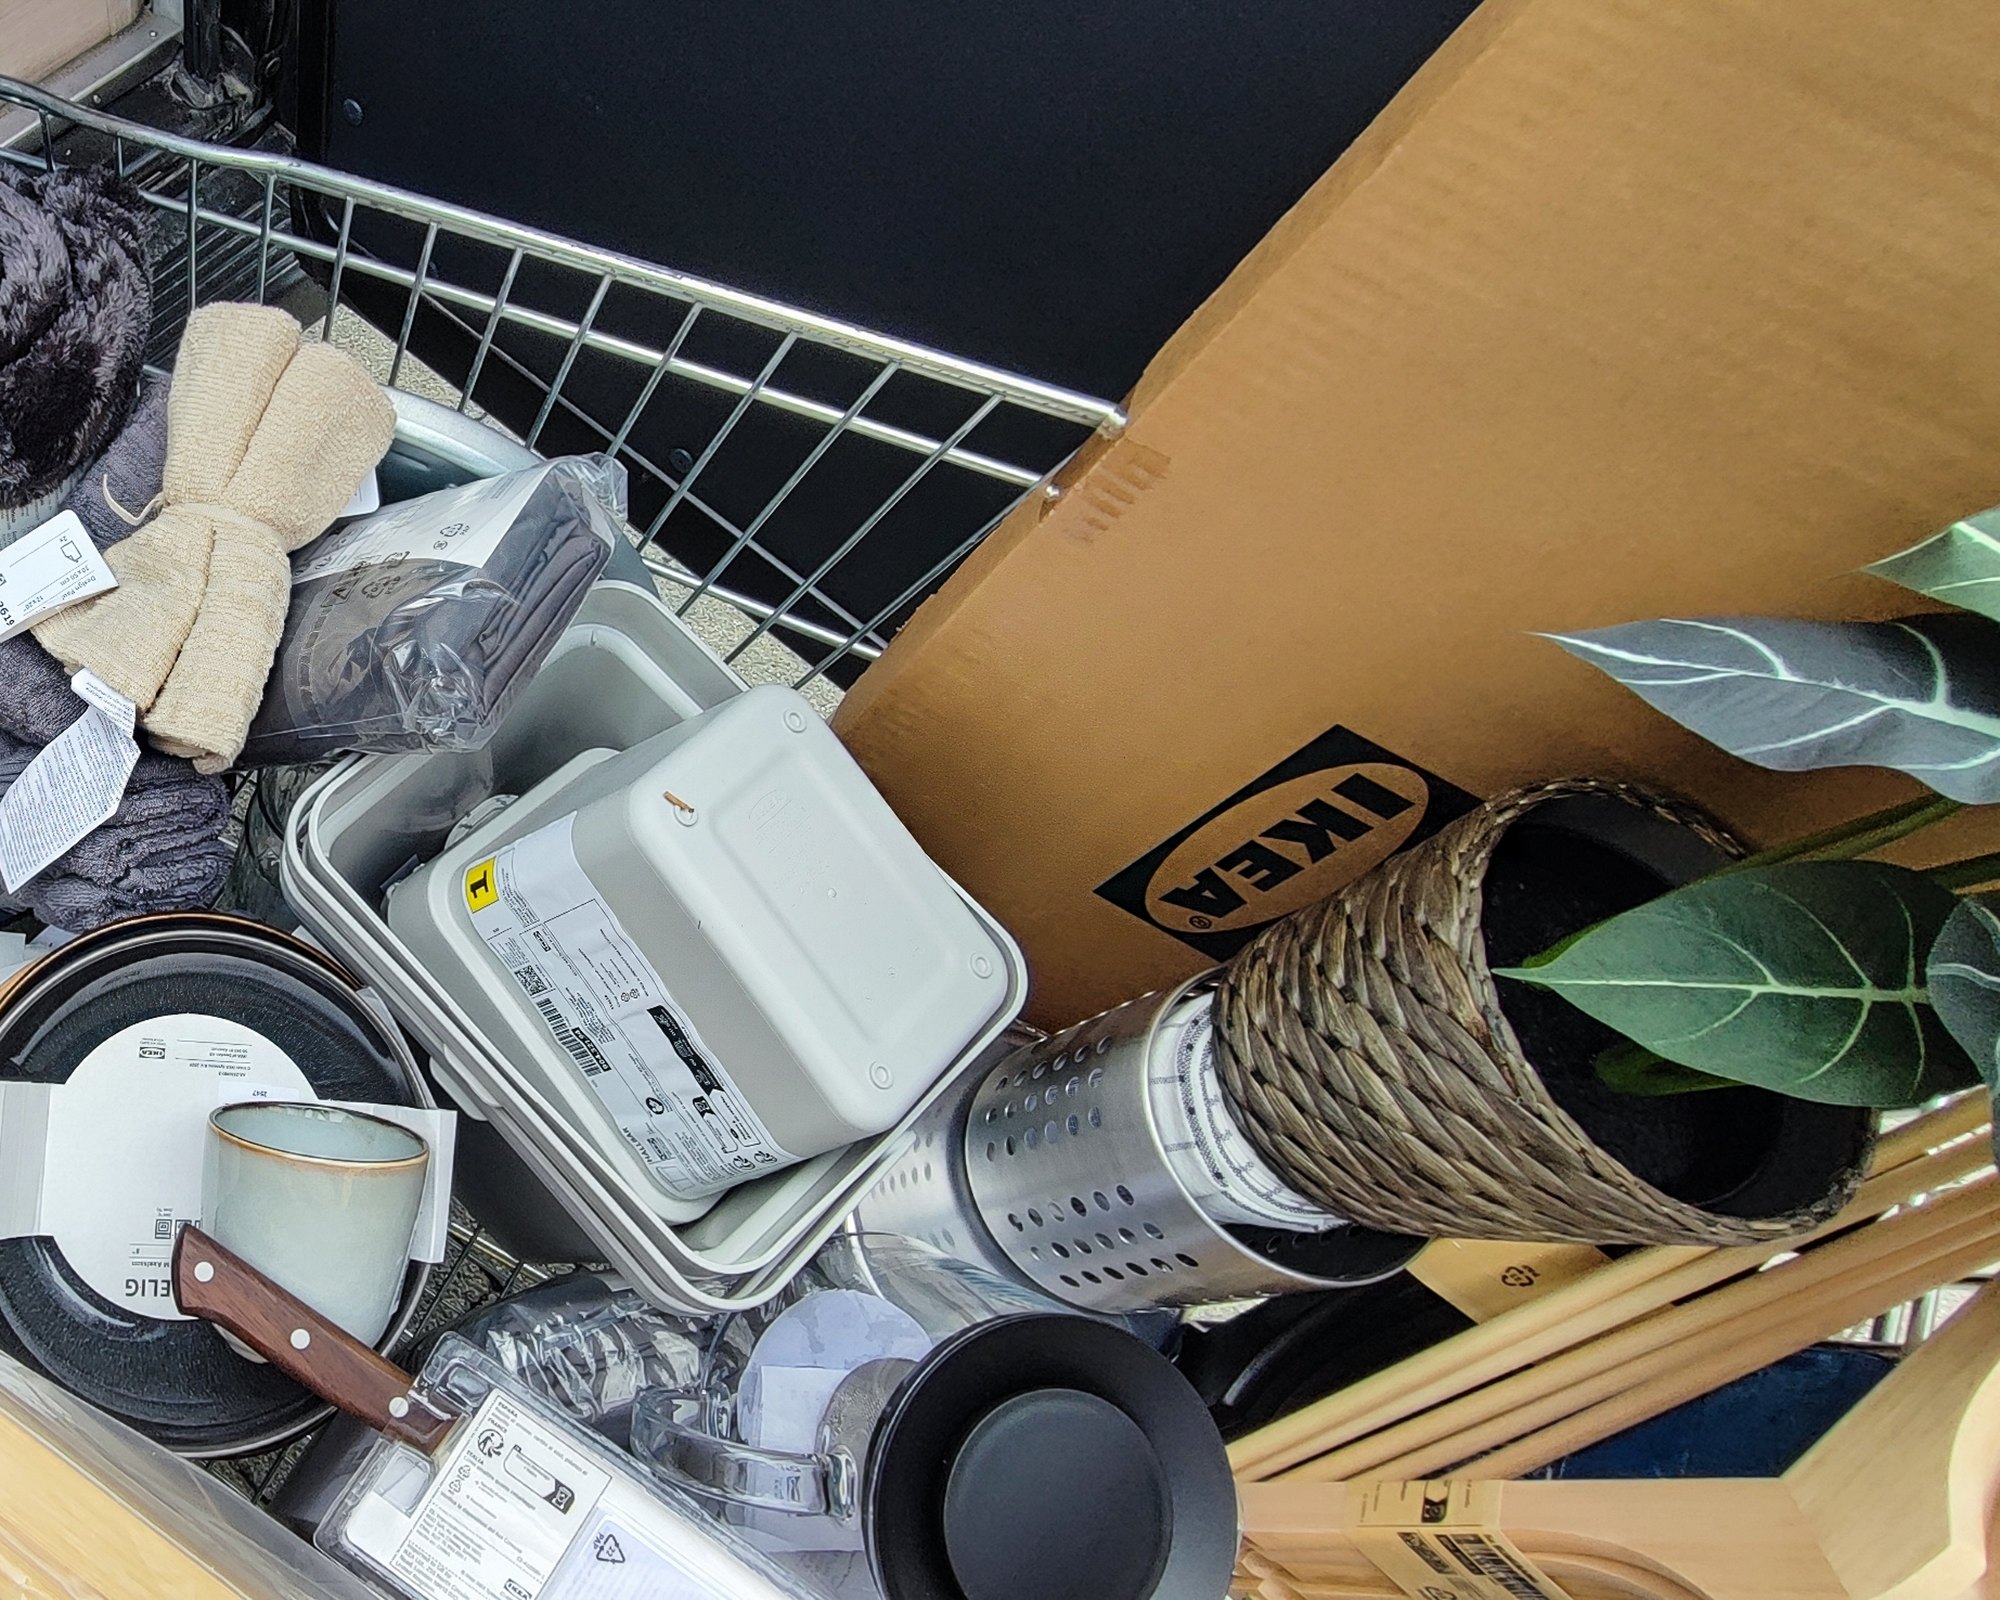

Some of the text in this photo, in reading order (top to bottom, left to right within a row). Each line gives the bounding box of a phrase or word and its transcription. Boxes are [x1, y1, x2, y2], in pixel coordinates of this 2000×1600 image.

[470, 869, 490, 898] 1
[574, 1029, 608, 1070] 904.321.94
[125, 1279, 171, 1297] ELIG
[593, 1532, 605, 1550] PAP
[605, 1546, 616, 1557] 22
